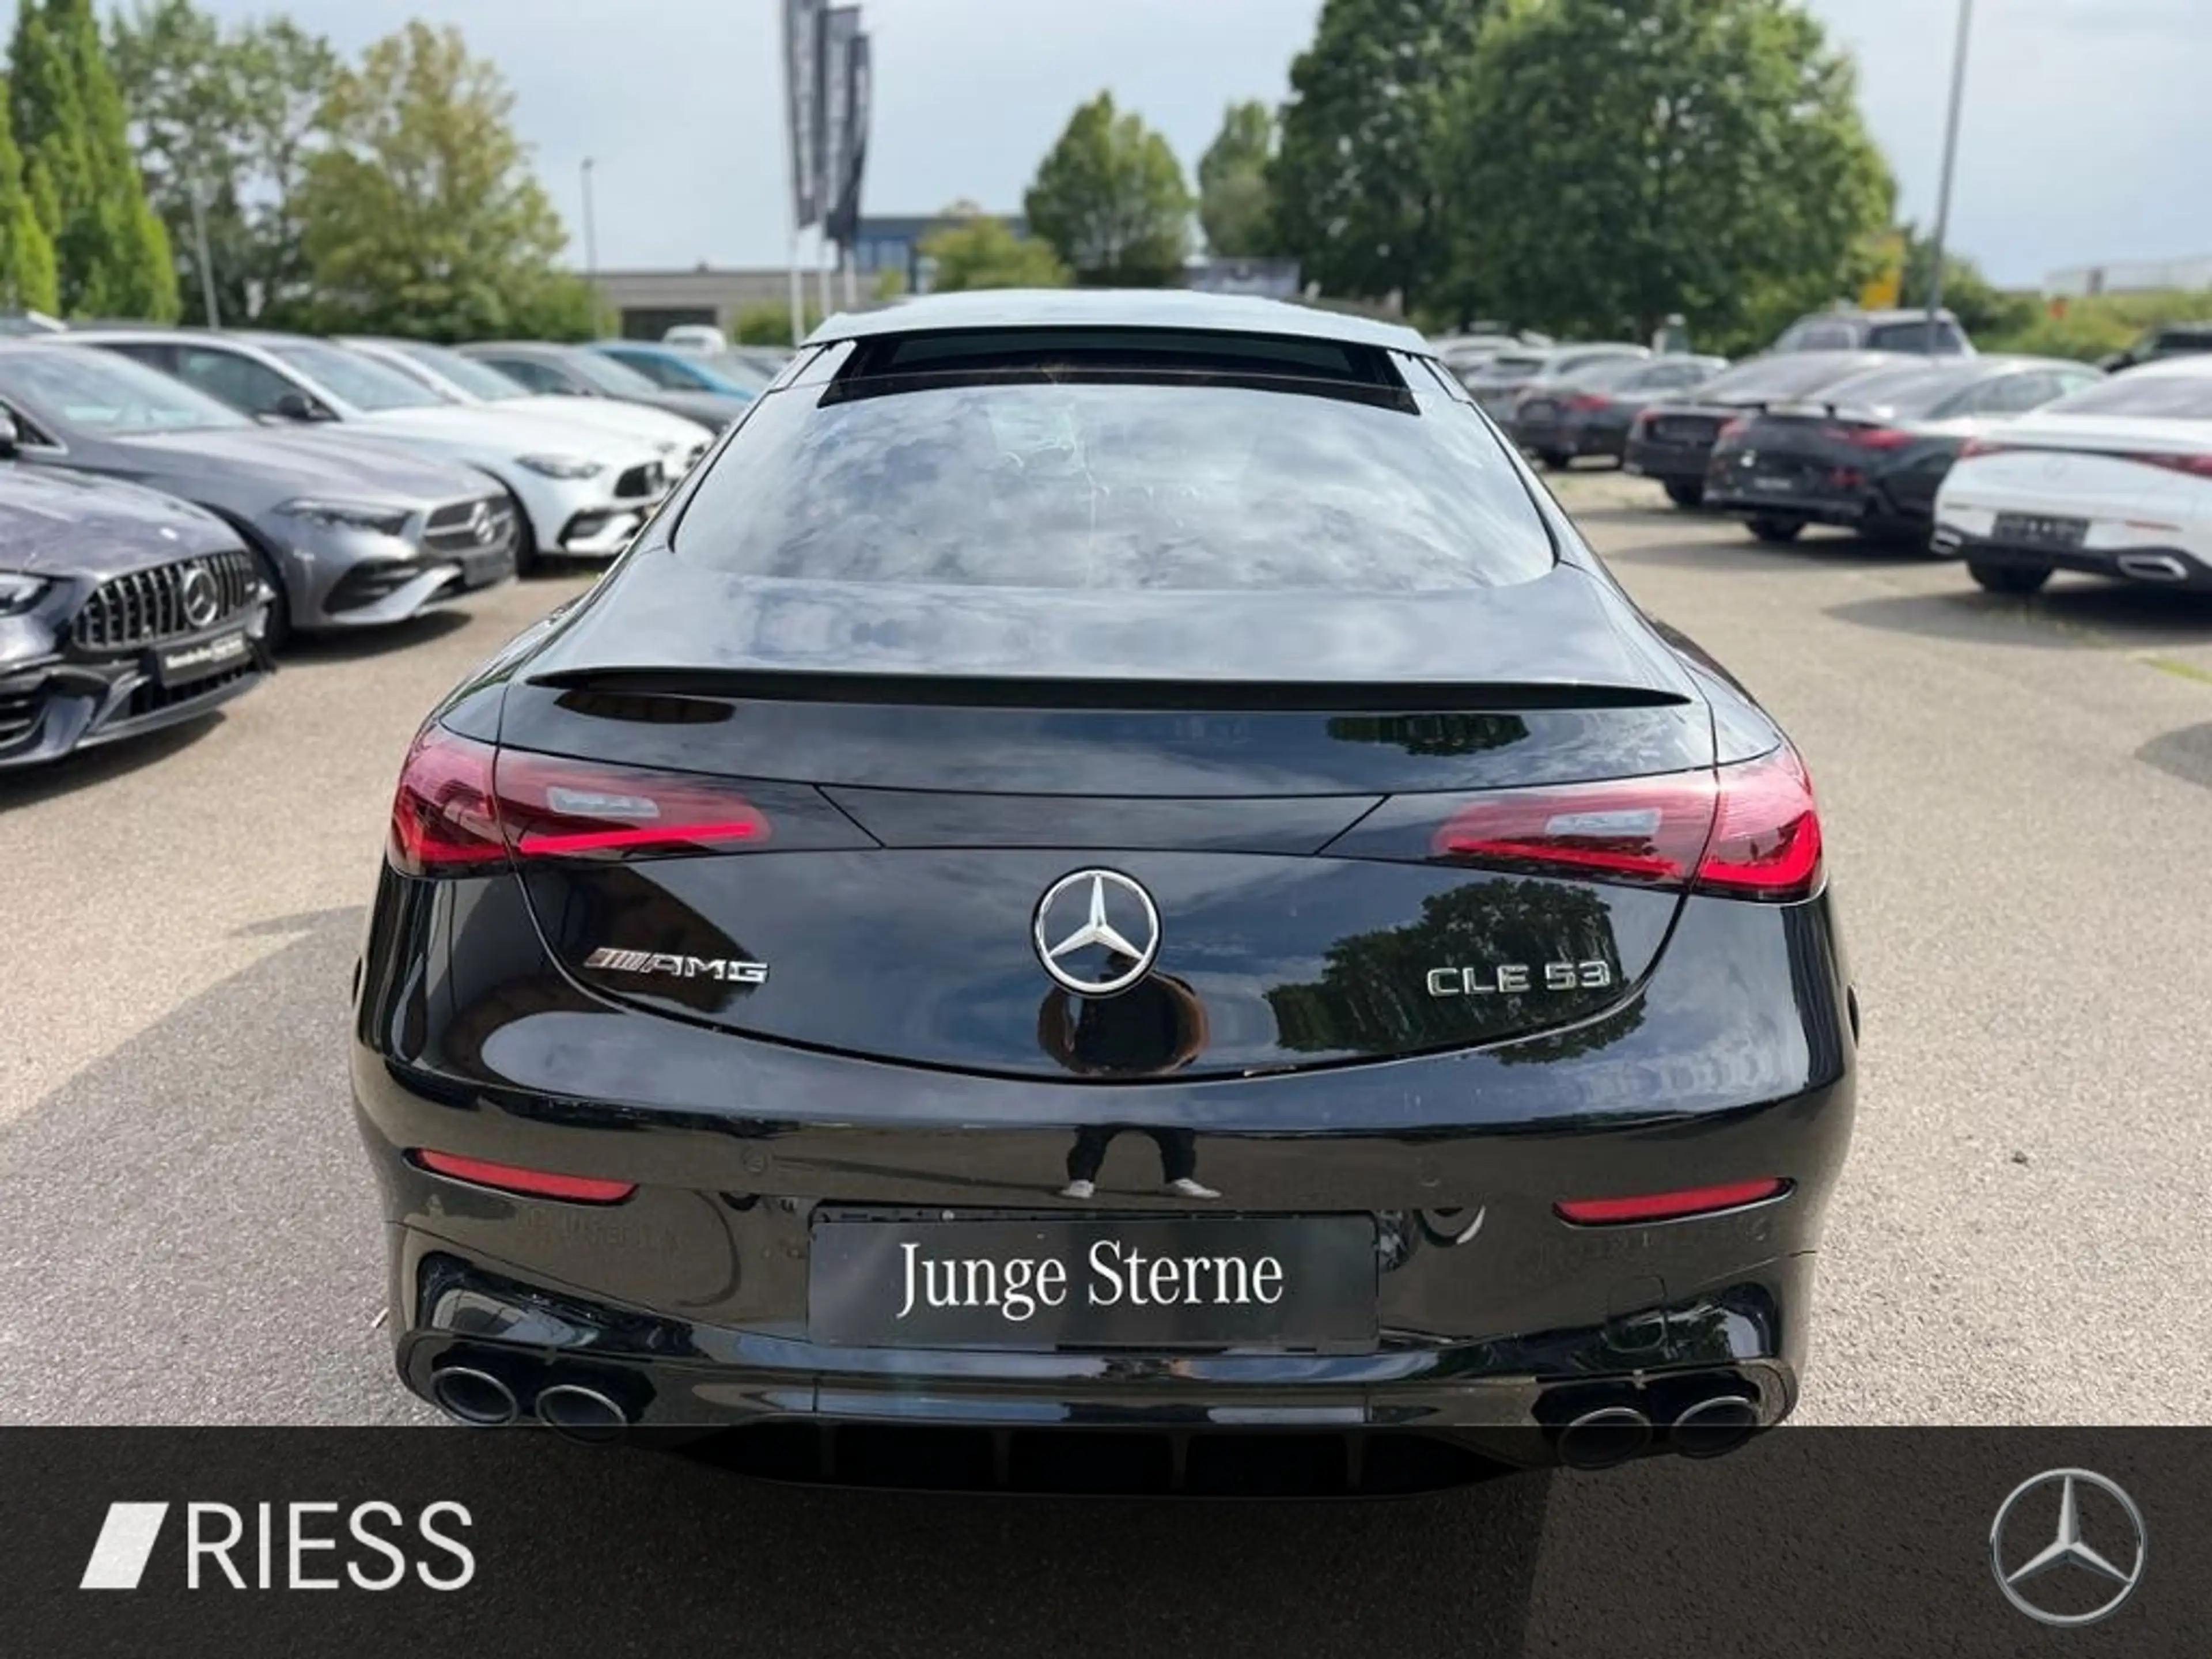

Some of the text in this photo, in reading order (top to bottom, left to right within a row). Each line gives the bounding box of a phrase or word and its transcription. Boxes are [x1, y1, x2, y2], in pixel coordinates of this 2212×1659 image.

[638, 952, 769, 984] AMG
[1427, 960, 1611, 997] CLE 53
[896, 1240, 1284, 1321] Junge Sterne
